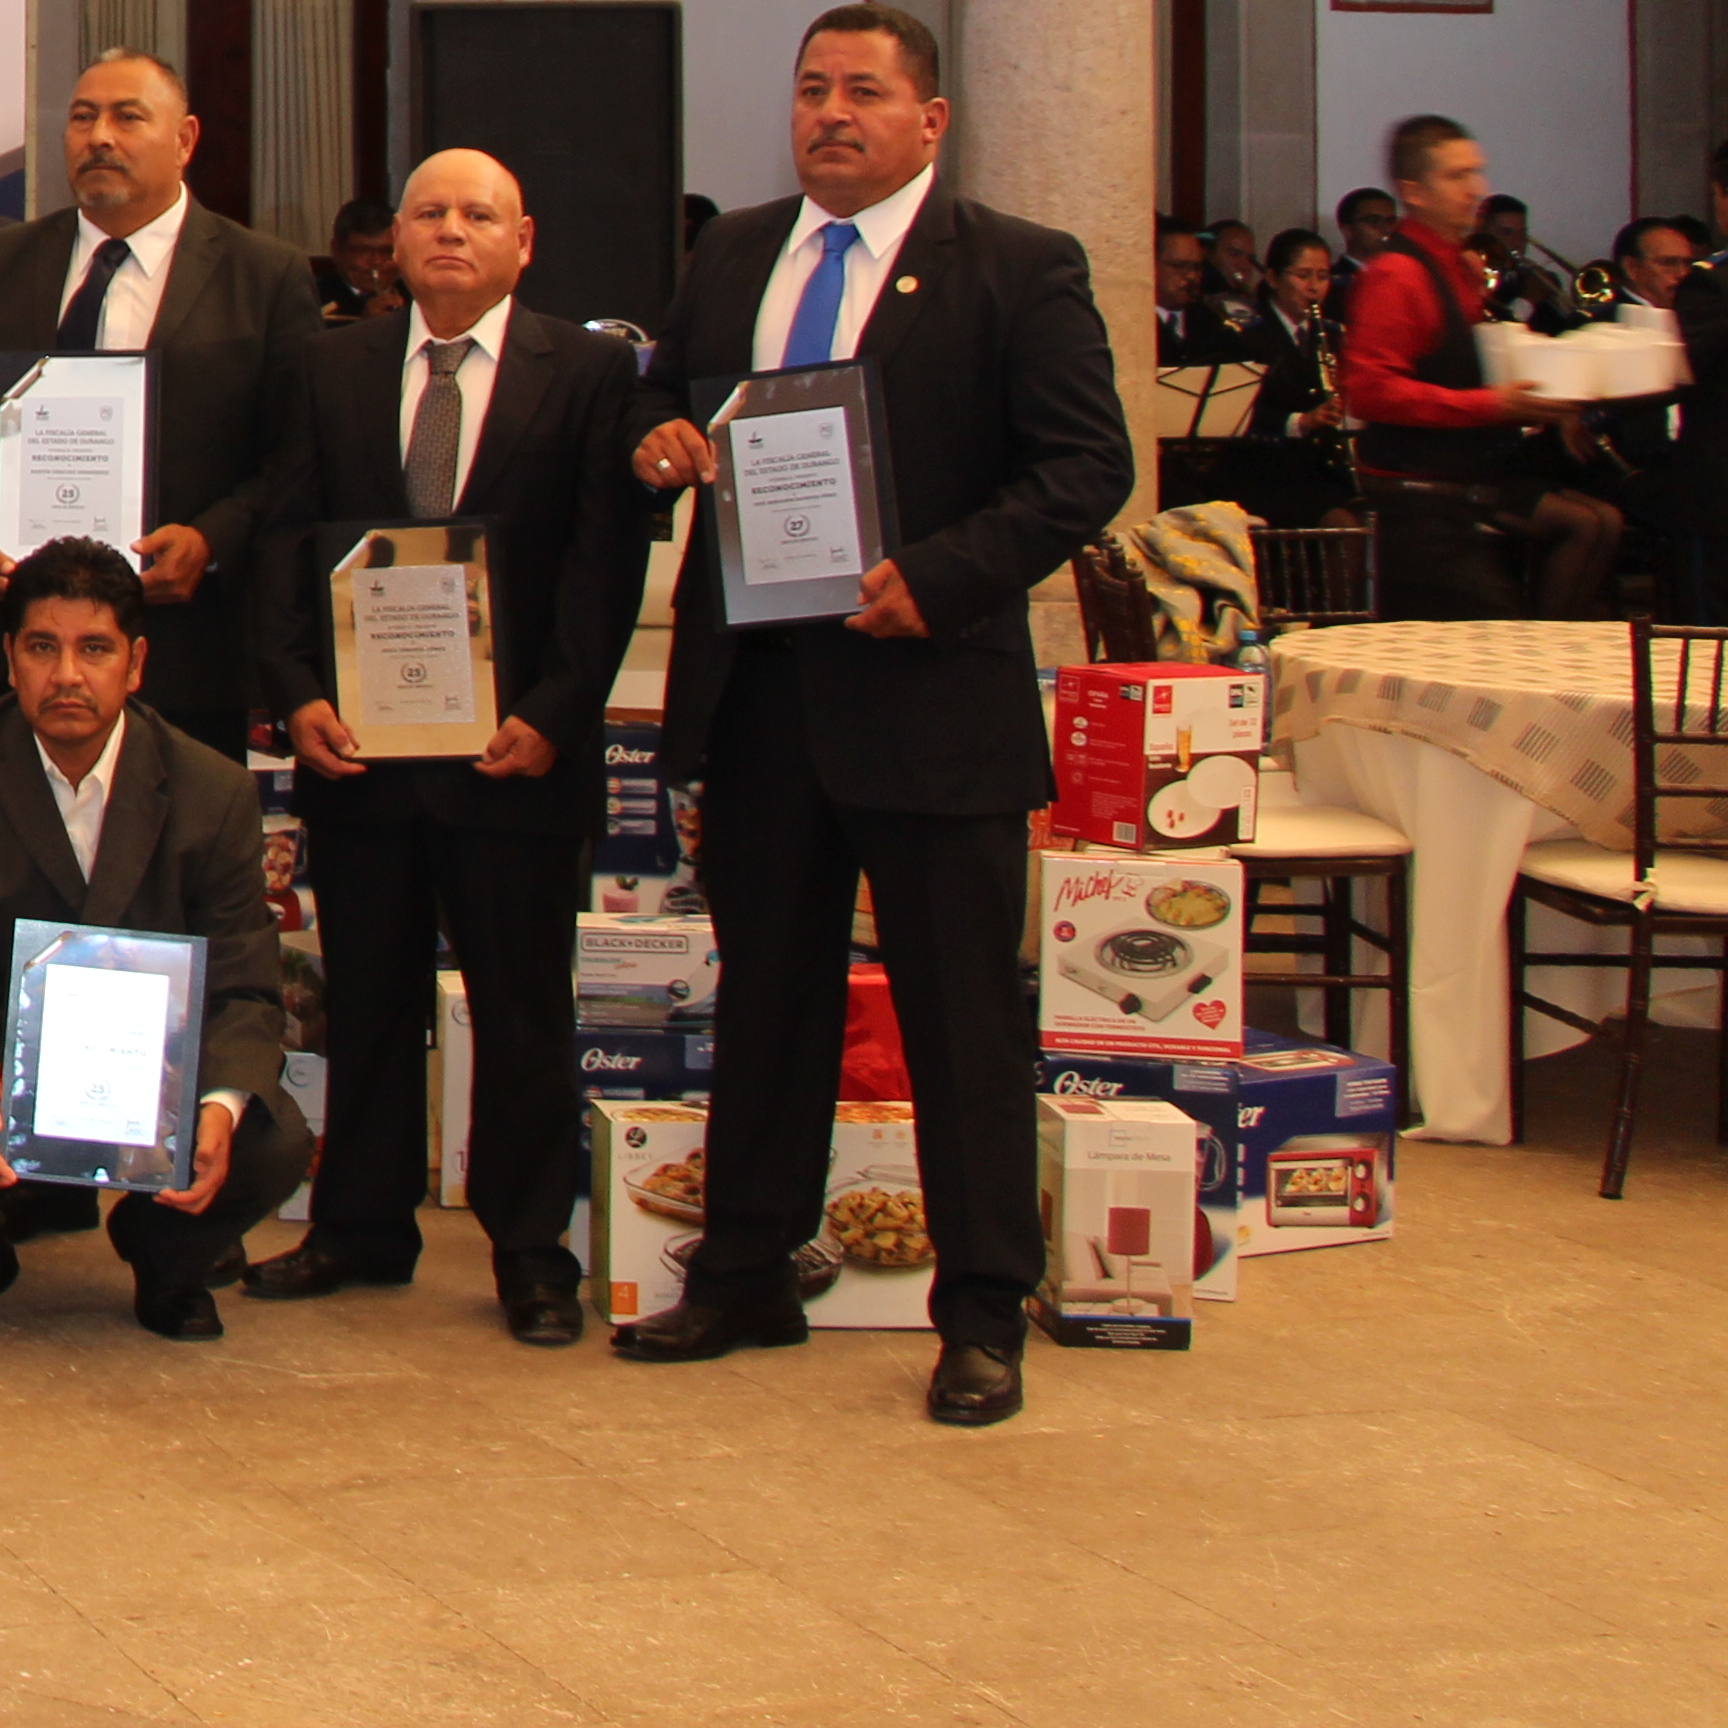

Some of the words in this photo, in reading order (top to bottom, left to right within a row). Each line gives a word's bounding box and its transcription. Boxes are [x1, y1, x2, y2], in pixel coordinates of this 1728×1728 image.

[61, 489, 74, 498] 25
[752, 478, 836, 495] RECONOCIMIENTO
[790, 521, 804, 530] 27
[371, 630, 455, 640] RECONOCIMIENTO
[605, 744, 655, 765] Oster
[586, 937, 684, 950] BLACK+DECKER
[580, 1047, 643, 1071] Oster
[1053, 1070, 1125, 1097] Oster
[1088, 1149, 1128, 1163] Lámpara
[1130, 1150, 1144, 1161] de
[1146, 1152, 1172, 1162] Mesa
[617, 1285, 630, 1301] 4
